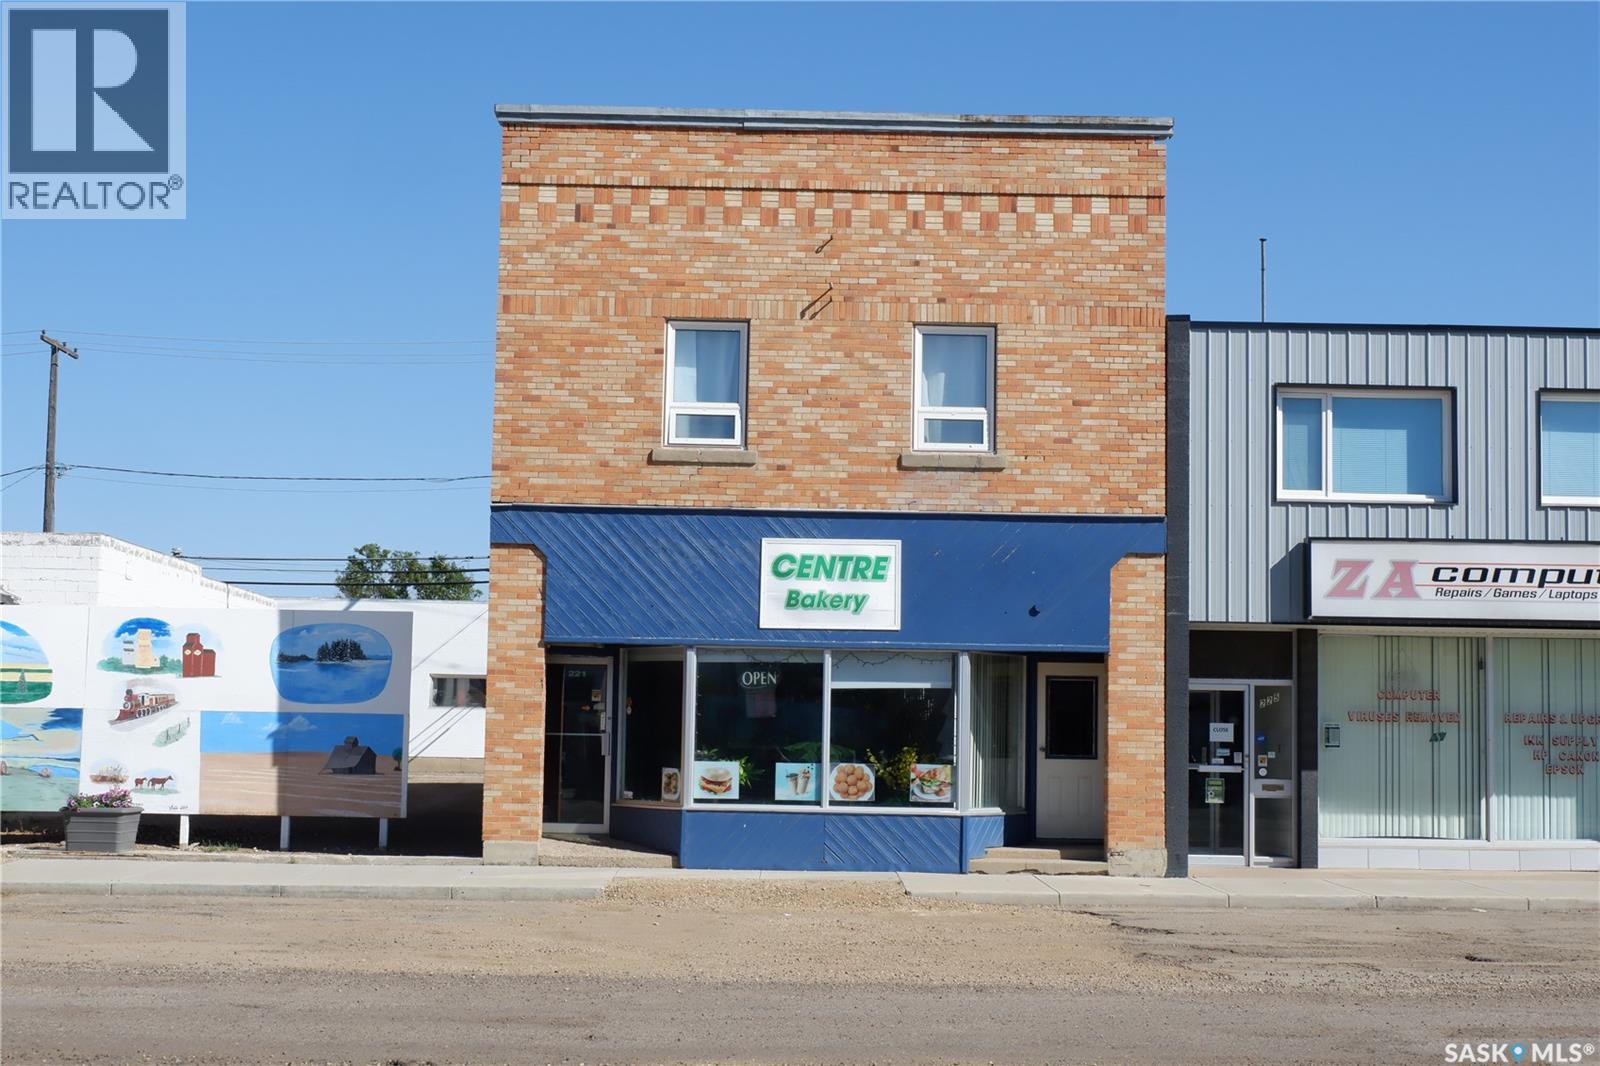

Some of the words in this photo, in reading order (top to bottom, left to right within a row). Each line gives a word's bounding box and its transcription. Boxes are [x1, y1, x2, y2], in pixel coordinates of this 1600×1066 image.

[771, 553, 891, 582] CENTRE
[1323, 559, 1422, 599] ZA
[784, 589, 869, 615] Bakery
[742, 671, 777, 686] OPEN
[1376, 689, 1440, 700] COMPUTER
[1347, 711, 1400, 723] VIRUSES
[1504, 713, 1557, 724] REPAIRS
[1551, 735, 1598, 748] SUPPLY
[1533, 749, 1548, 761] HP
[1558, 750, 1600, 763] CANON
[1545, 763, 1585, 775] EPSON
